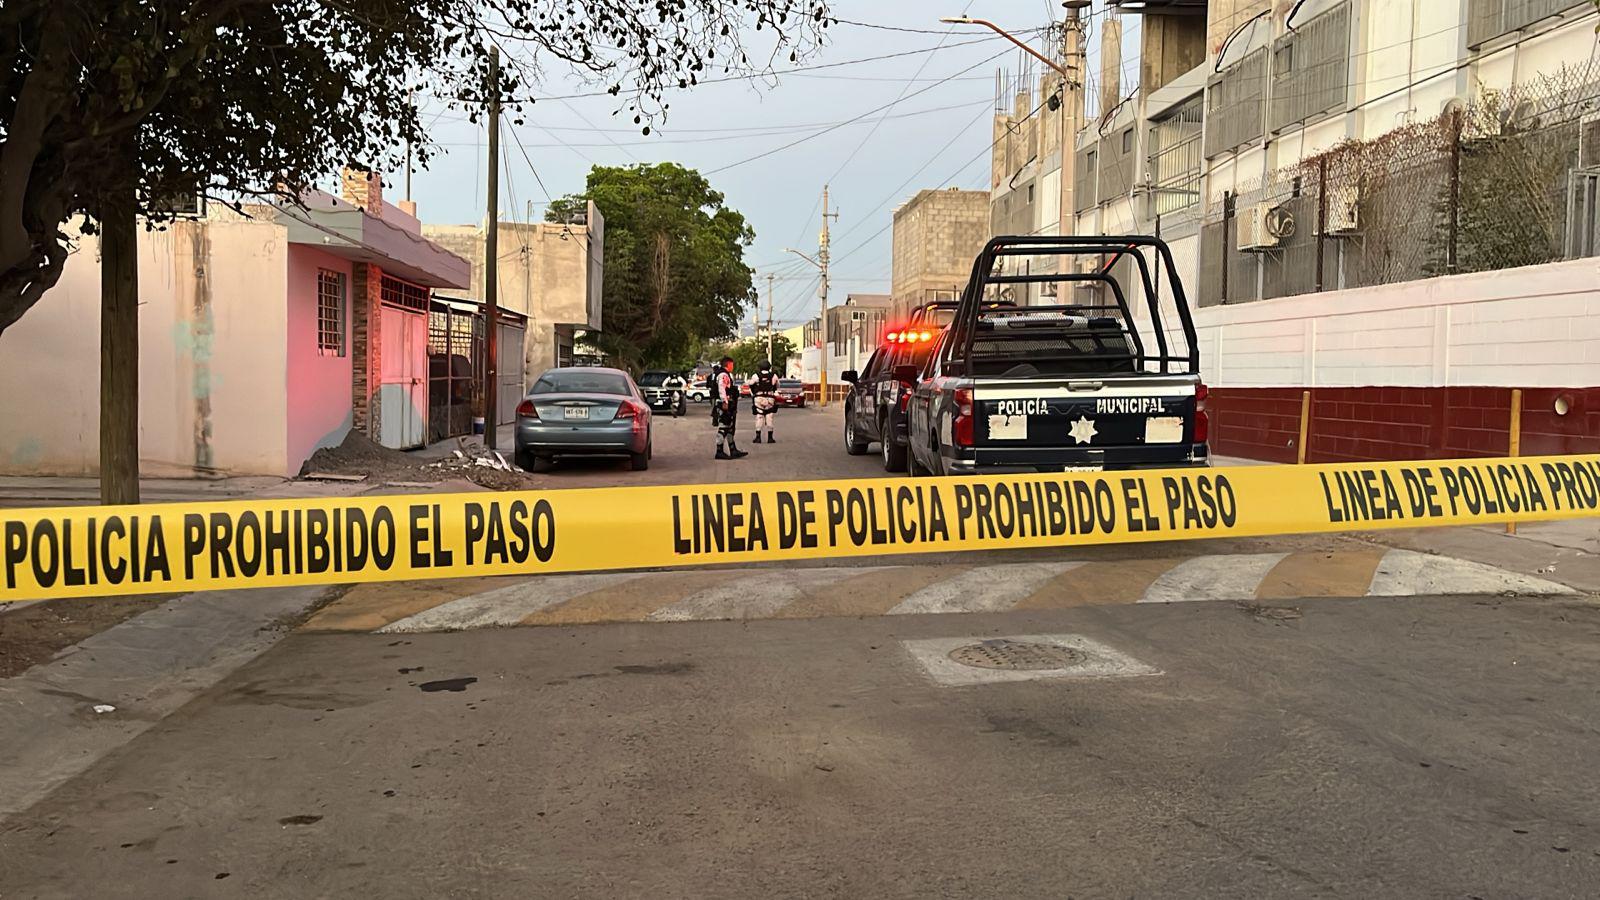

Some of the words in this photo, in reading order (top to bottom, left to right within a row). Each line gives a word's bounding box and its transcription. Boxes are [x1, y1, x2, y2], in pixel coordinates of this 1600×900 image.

[1096, 397, 1165, 414] MUNICIPAL
[672, 492, 769, 555] LINEA
[776, 490, 818, 550] DE
[825, 485, 950, 547] POLICIA
[954, 478, 1116, 541] PROHIBIDO
[1121, 477, 1160, 533] EL
[1161, 474, 1237, 530] PASO
[1319, 469, 1404, 523] LINEA
[1401, 467, 1443, 518] DE
[1439, 463, 1547, 516] POLICIA
[5, 514, 172, 589] POLICIA
[184, 505, 396, 580] PROHIBIDO
[409, 504, 453, 568] EL
[464, 499, 556, 566] PASO
